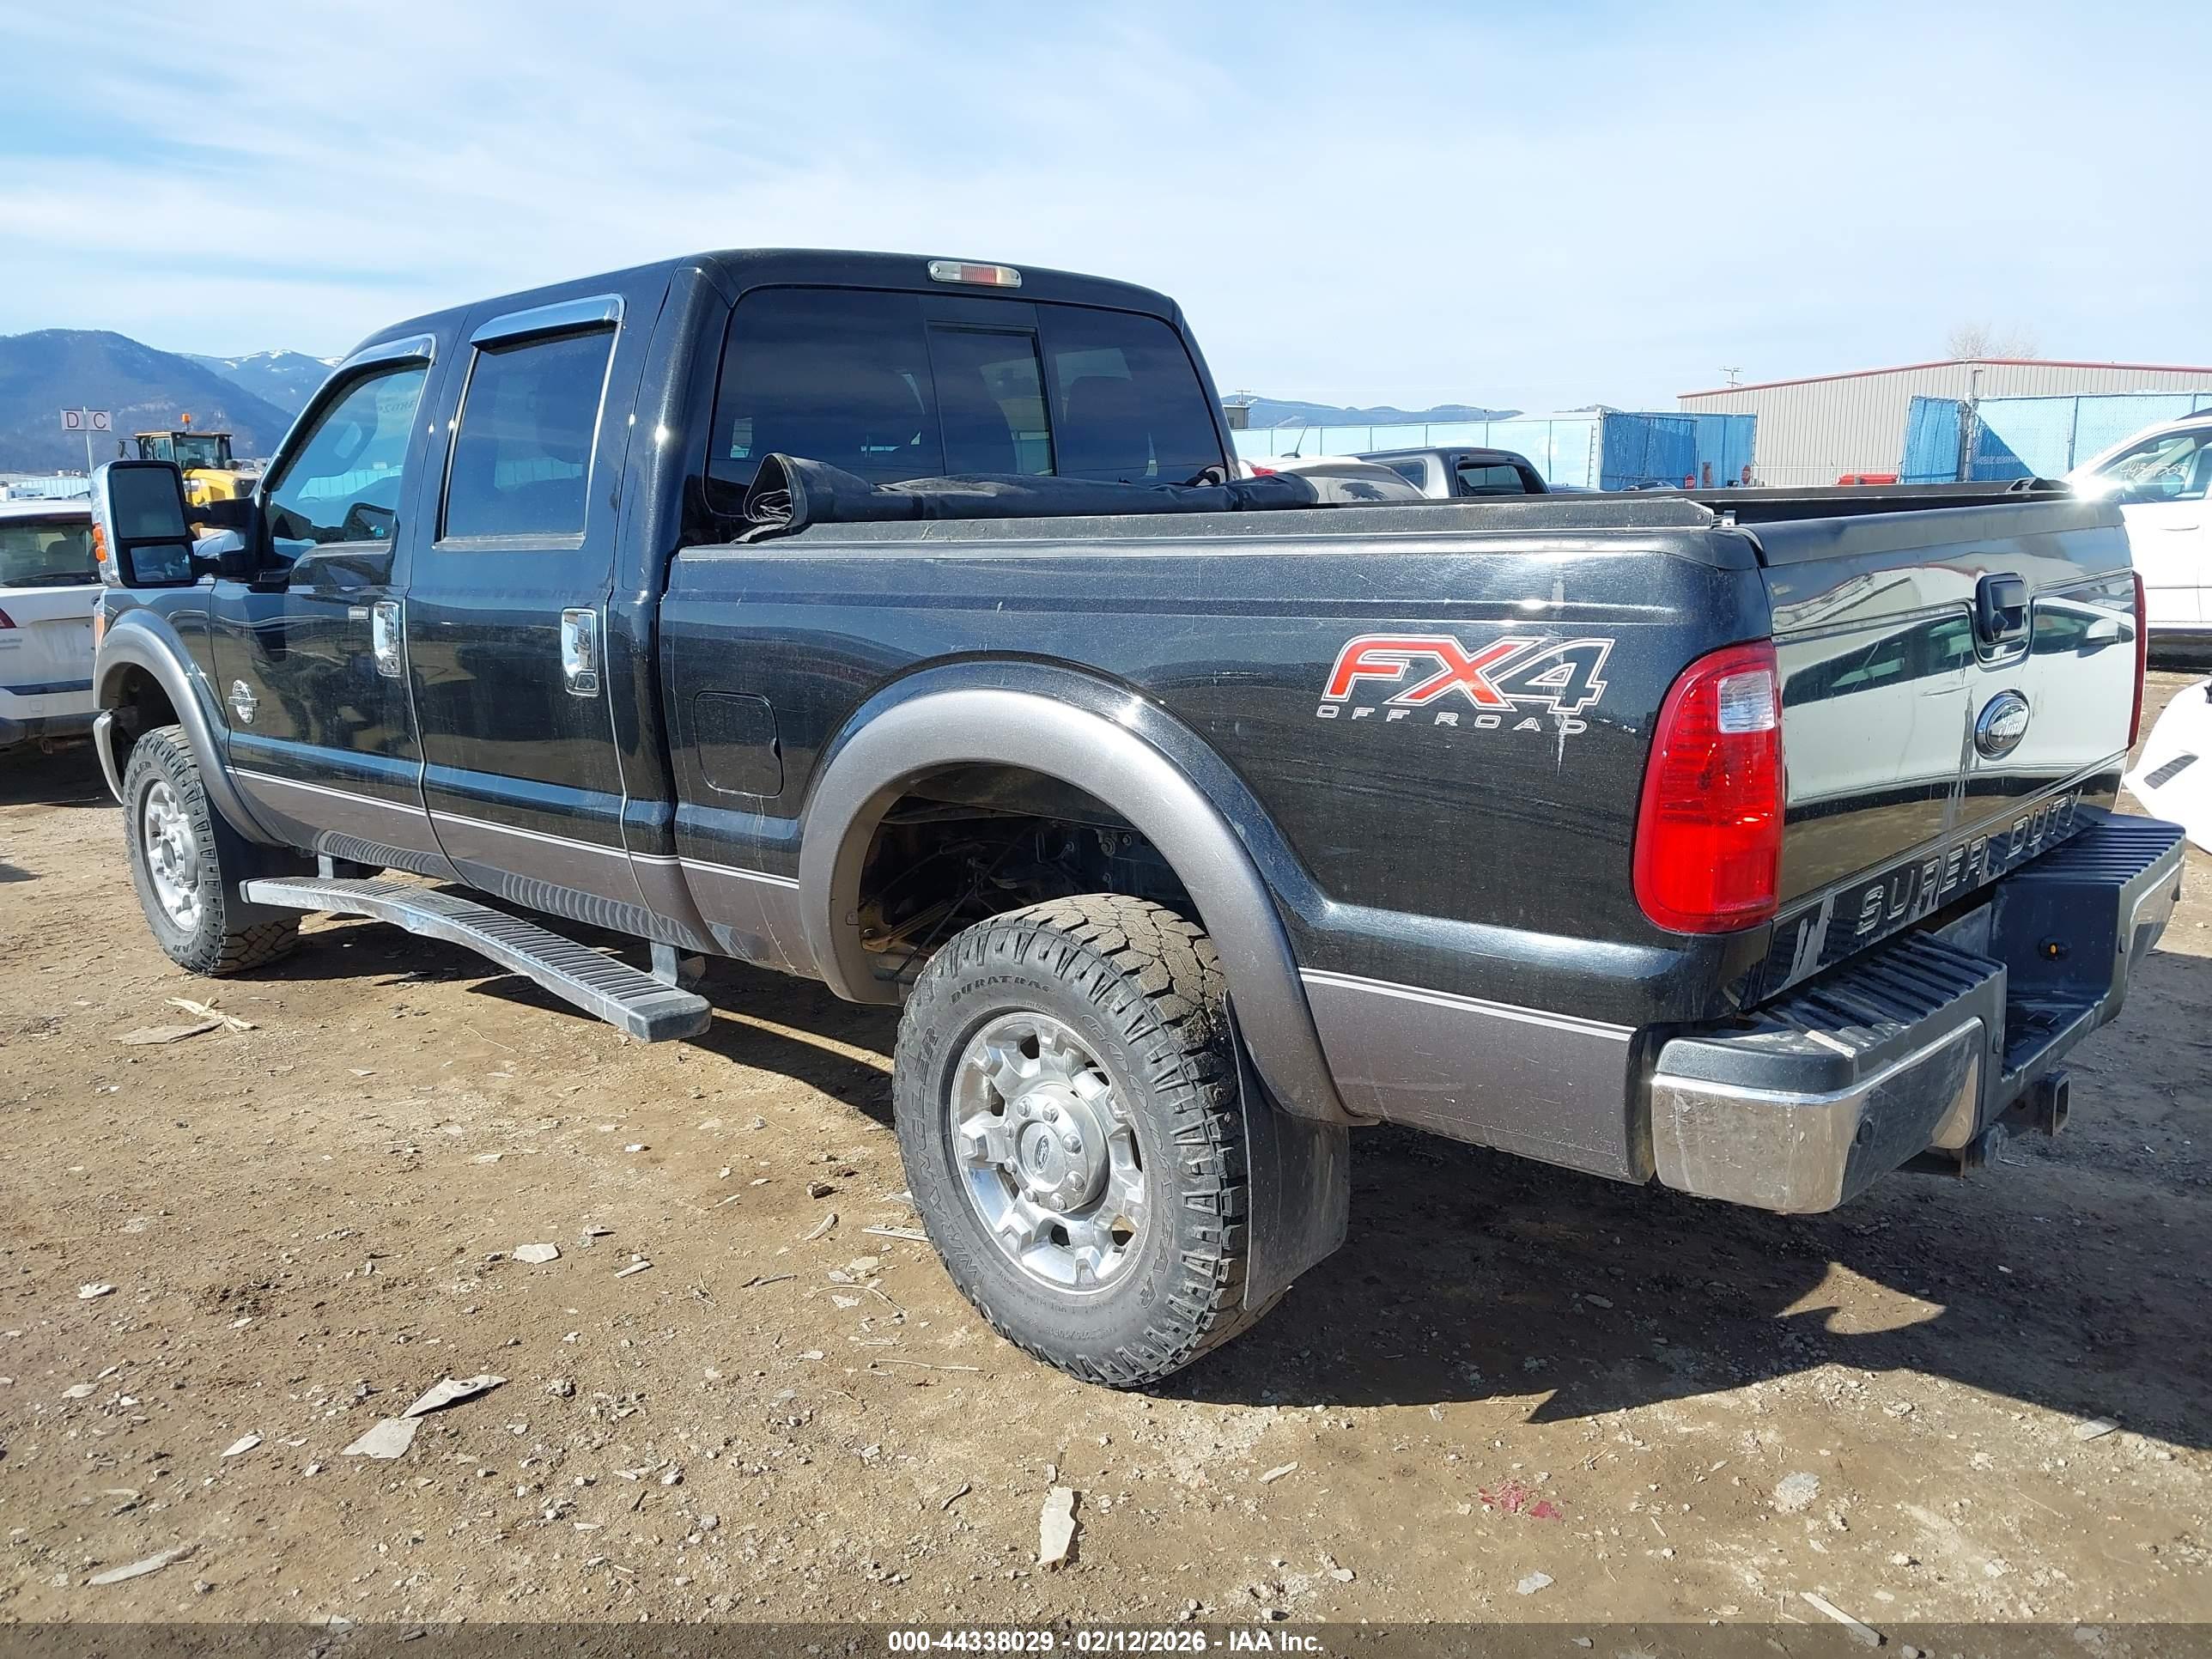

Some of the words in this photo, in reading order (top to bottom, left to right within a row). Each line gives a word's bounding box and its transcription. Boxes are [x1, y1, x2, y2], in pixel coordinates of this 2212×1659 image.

[66, 412, 79, 428] D
[94, 413, 106, 428] C
[1321, 633, 1616, 716] FX4
[1316, 704, 1411, 722] OFF
[1434, 711, 1588, 734] ROAD
[1997, 710, 2027, 743] Ford
[1855, 833, 1990, 936] SUPER
[2004, 785, 2084, 860] DUTY
[950, 975, 1054, 1005] DURATRAC
[911, 1025, 986, 1289] WRANGLER
[1081, 1013, 1175, 1310] GOODYEAR
